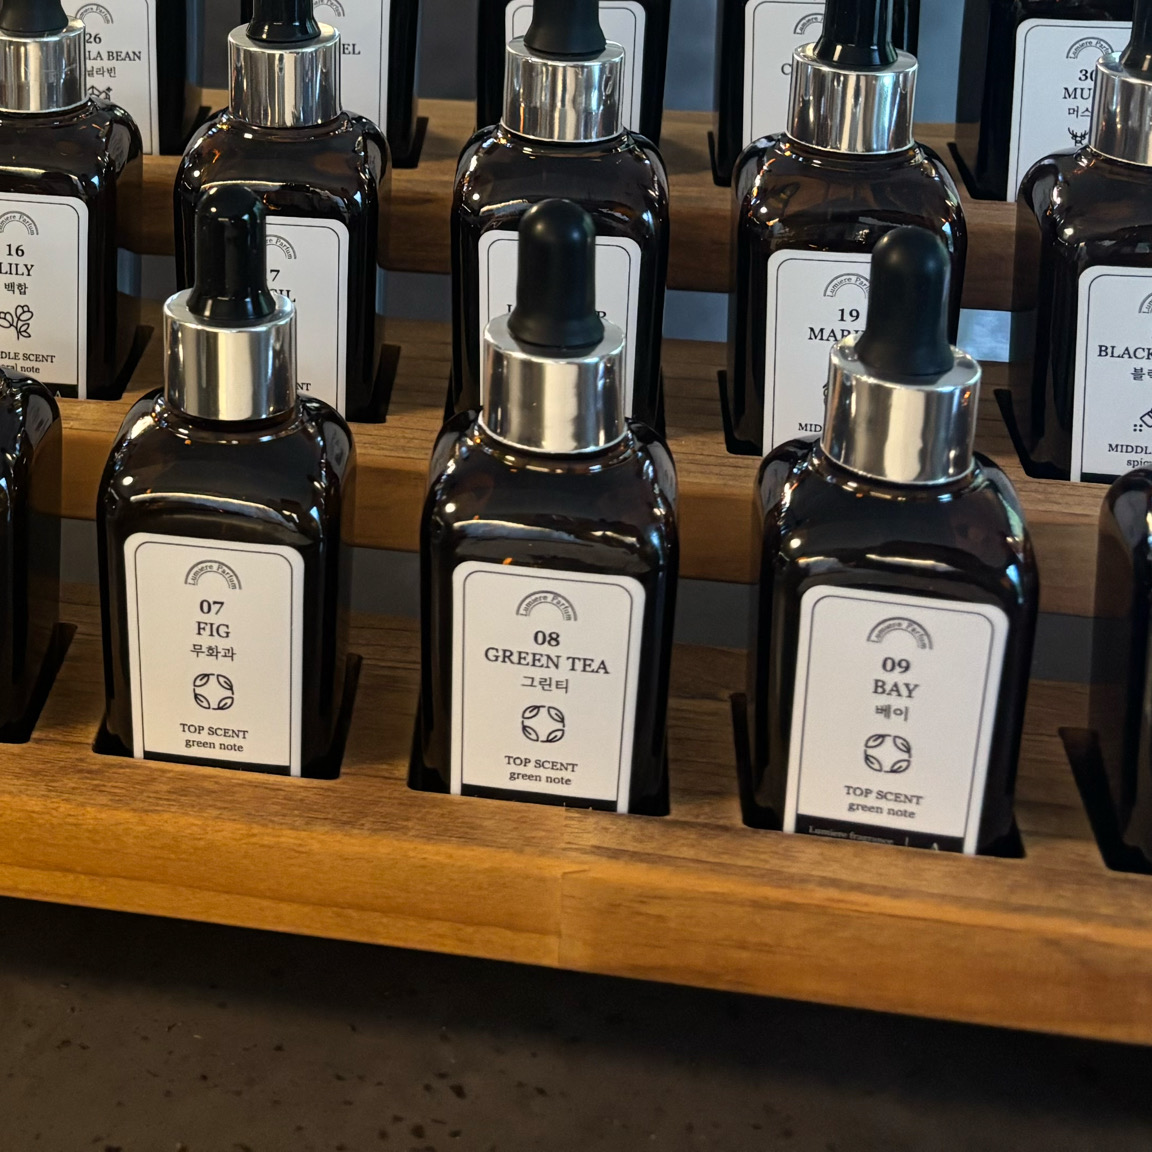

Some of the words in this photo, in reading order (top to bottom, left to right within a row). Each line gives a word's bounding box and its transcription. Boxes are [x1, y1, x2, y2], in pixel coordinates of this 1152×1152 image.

[85, 32, 102, 44] 26
[106, 50, 142, 62] BEAN
[1063, 87, 1093, 100] MU
[1067, 106, 1092, 119] 머스
[6, 243, 25, 257] 16
[275, 237, 293, 260] Parfum
[4, 282, 29, 296] 백합
[826, 276, 853, 298] Lumiere
[838, 308, 860, 323] 19
[22, 352, 56, 364] SCENT
[20, 365, 41, 374] note
[1108, 444, 1152, 455] MIDDL
[188, 564, 214, 586] Lumiere
[216, 564, 237, 590] Parfum
[199, 599, 225, 615] 07
[519, 595, 548, 617] Lumiere
[550, 594, 572, 621] Parfum
[196, 621, 231, 638] FIG
[534, 630, 560, 647] 08
[190, 643, 237, 661] 무화과
[484, 647, 562, 670] GREEN
[566, 656, 611, 674] TEA
[882, 656, 911, 674] 09
[521, 676, 569, 694] 그린티
[872, 679, 920, 698] BAY
[875, 704, 910, 722] 베이
[179, 723, 205, 735] TOP
[207, 726, 248, 740] SCENT
[185, 739, 216, 749] green
[219, 743, 244, 752] note
[504, 755, 531, 767] TOP
[534, 759, 578, 773] SCENT
[509, 771, 542, 781] green
[545, 776, 572, 786] note
[844, 785, 873, 798] TOP
[876, 789, 924, 805] SCENT
[848, 801, 883, 814] green
[886, 808, 916, 819] note
